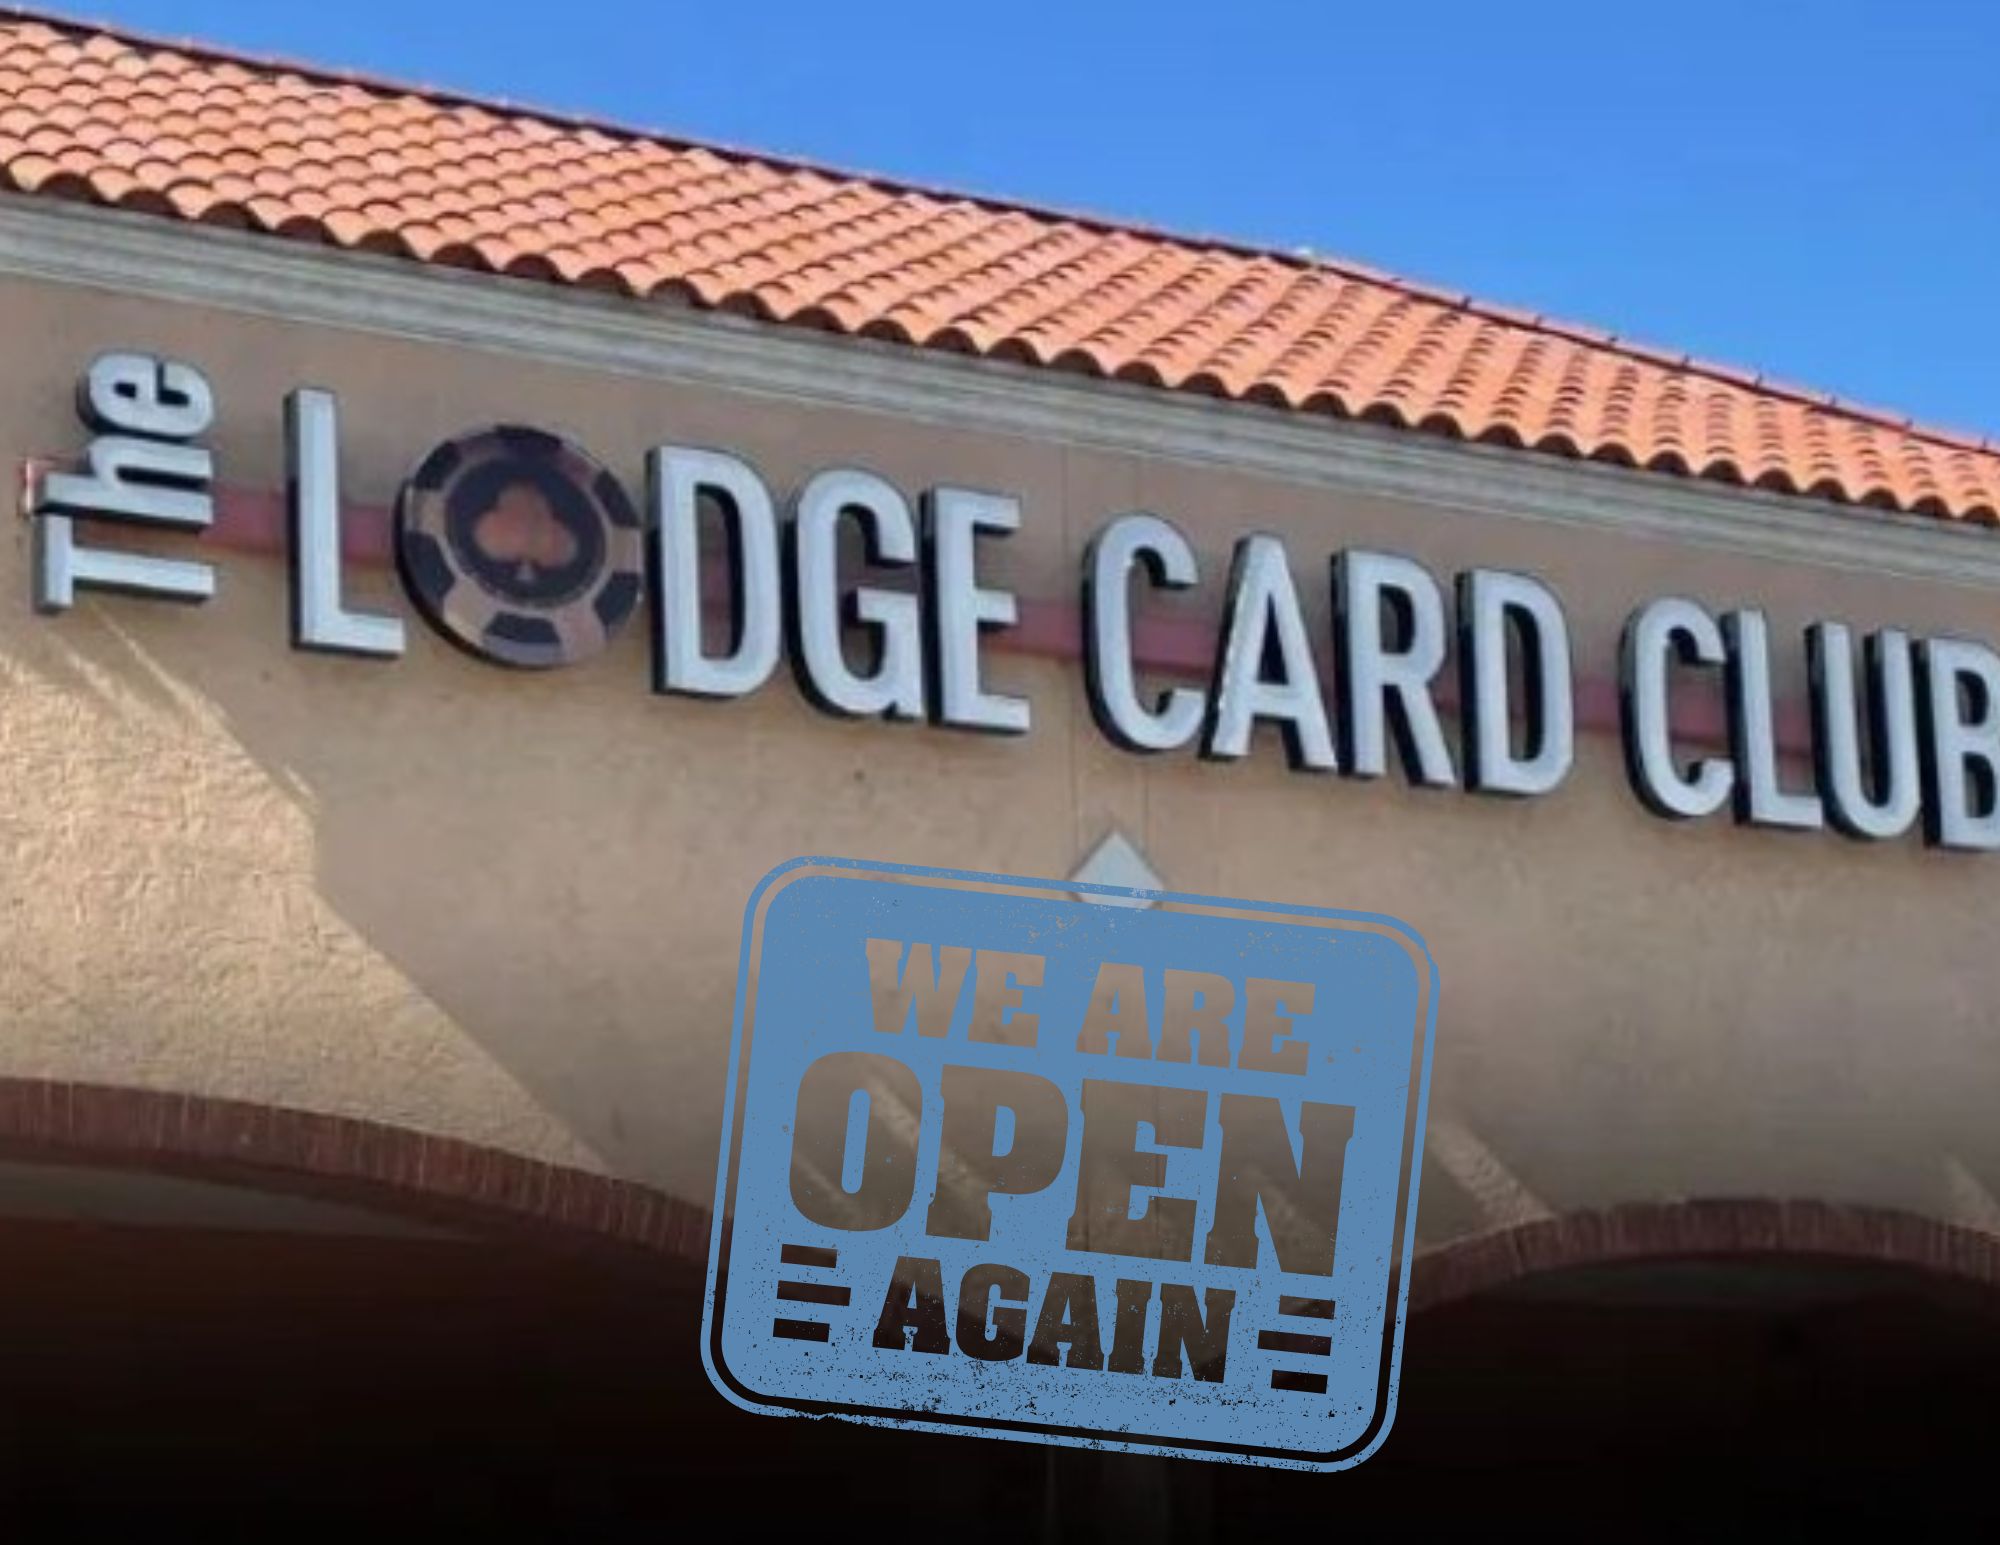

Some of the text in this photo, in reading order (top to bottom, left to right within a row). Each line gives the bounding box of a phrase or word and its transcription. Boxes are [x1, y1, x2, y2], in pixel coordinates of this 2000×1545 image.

[36, 352, 216, 613] The
[1083, 512, 1575, 796] CARD
[1620, 597, 2000, 849] CLUB
